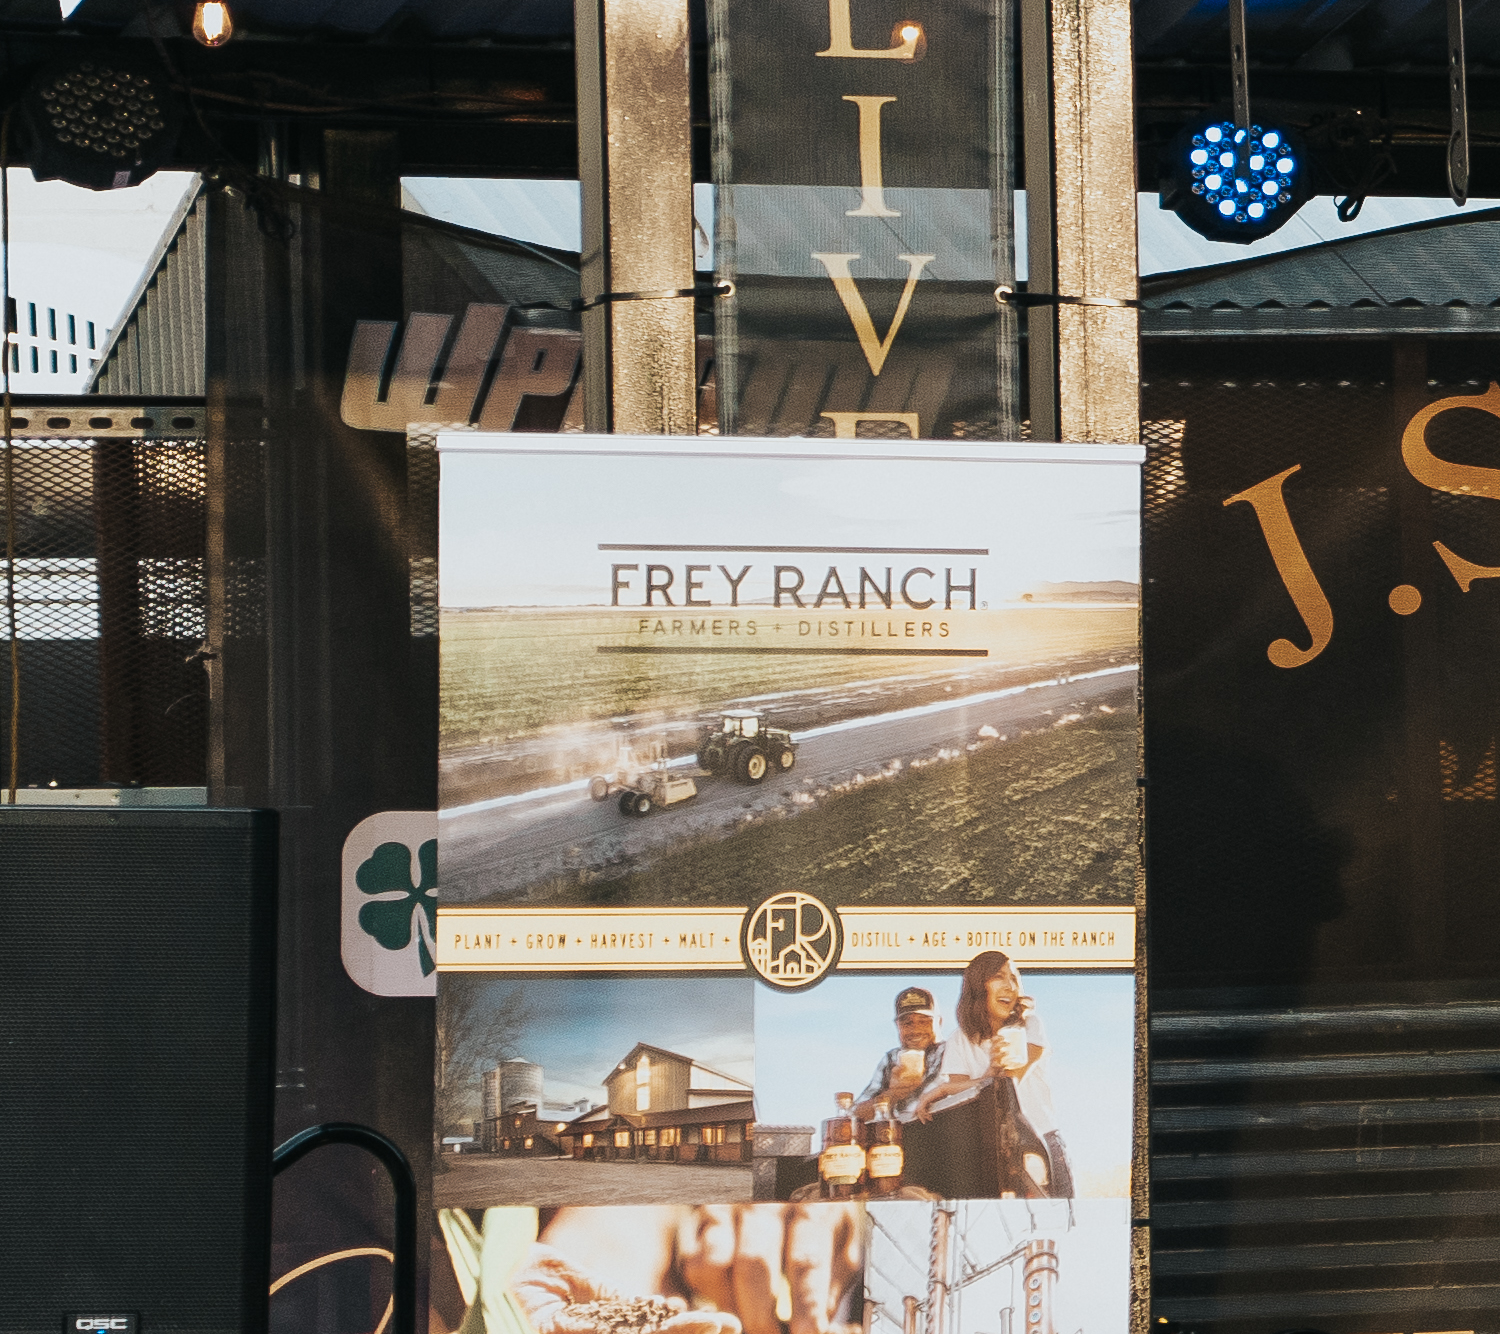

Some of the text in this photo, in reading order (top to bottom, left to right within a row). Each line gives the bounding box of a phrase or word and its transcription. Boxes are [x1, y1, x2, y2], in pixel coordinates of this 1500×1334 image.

[610, 563, 978, 611] FREY RANCH
[638, 619, 758, 637] FARMERS
[798, 620, 951, 638] DISTILLERS
[454, 933, 502, 950] PLANT
[525, 933, 567, 950] GROW
[589, 932, 655, 950] HARVEST
[678, 932, 716, 949] MALT
[851, 931, 901, 948] DISTILL
[921, 931, 948, 947] AGE
[966, 930, 1013, 948] BOTTLE
[1018, 931, 1037, 948] ON
[1042, 931, 1066, 947] THE
[1071, 931, 1116, 948] RANCH
[75, 1318, 128, 1330] QSC
